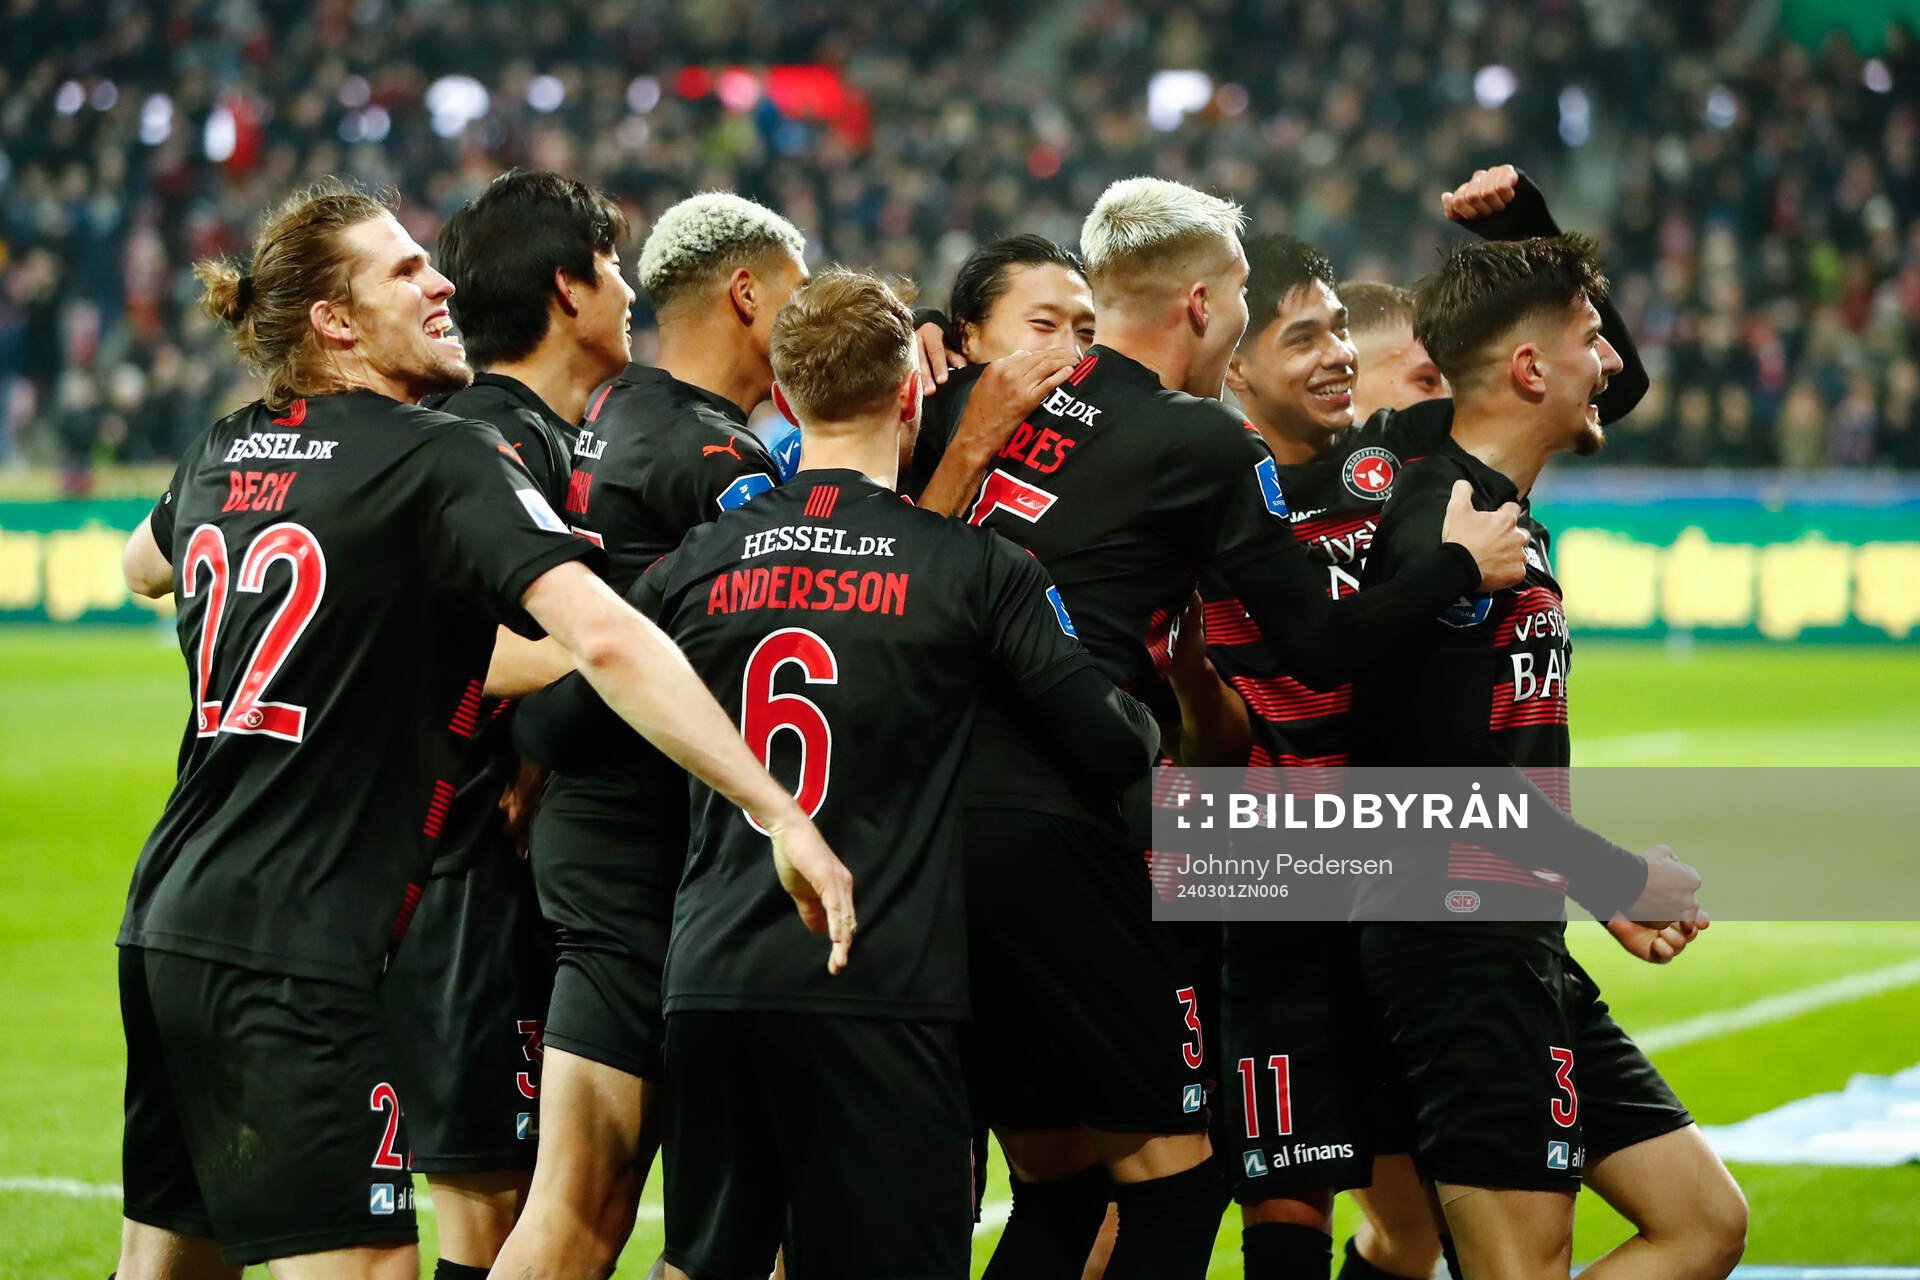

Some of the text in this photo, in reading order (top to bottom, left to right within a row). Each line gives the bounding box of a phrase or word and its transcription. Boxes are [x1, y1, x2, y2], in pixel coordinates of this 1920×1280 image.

[222, 470, 298, 512] BECH
[741, 526, 895, 559] HESSEL.DK
[707, 566, 910, 615] ANDERSSON
[183, 522, 326, 743] 22
[741, 627, 838, 836] 6
[1237, 1055, 1292, 1138] 11
[1549, 1046, 1577, 1127] 3
[370, 1082, 413, 1170] 2
[1273, 1143, 1354, 1169] al finans
[398, 1186, 407, 1210] al
